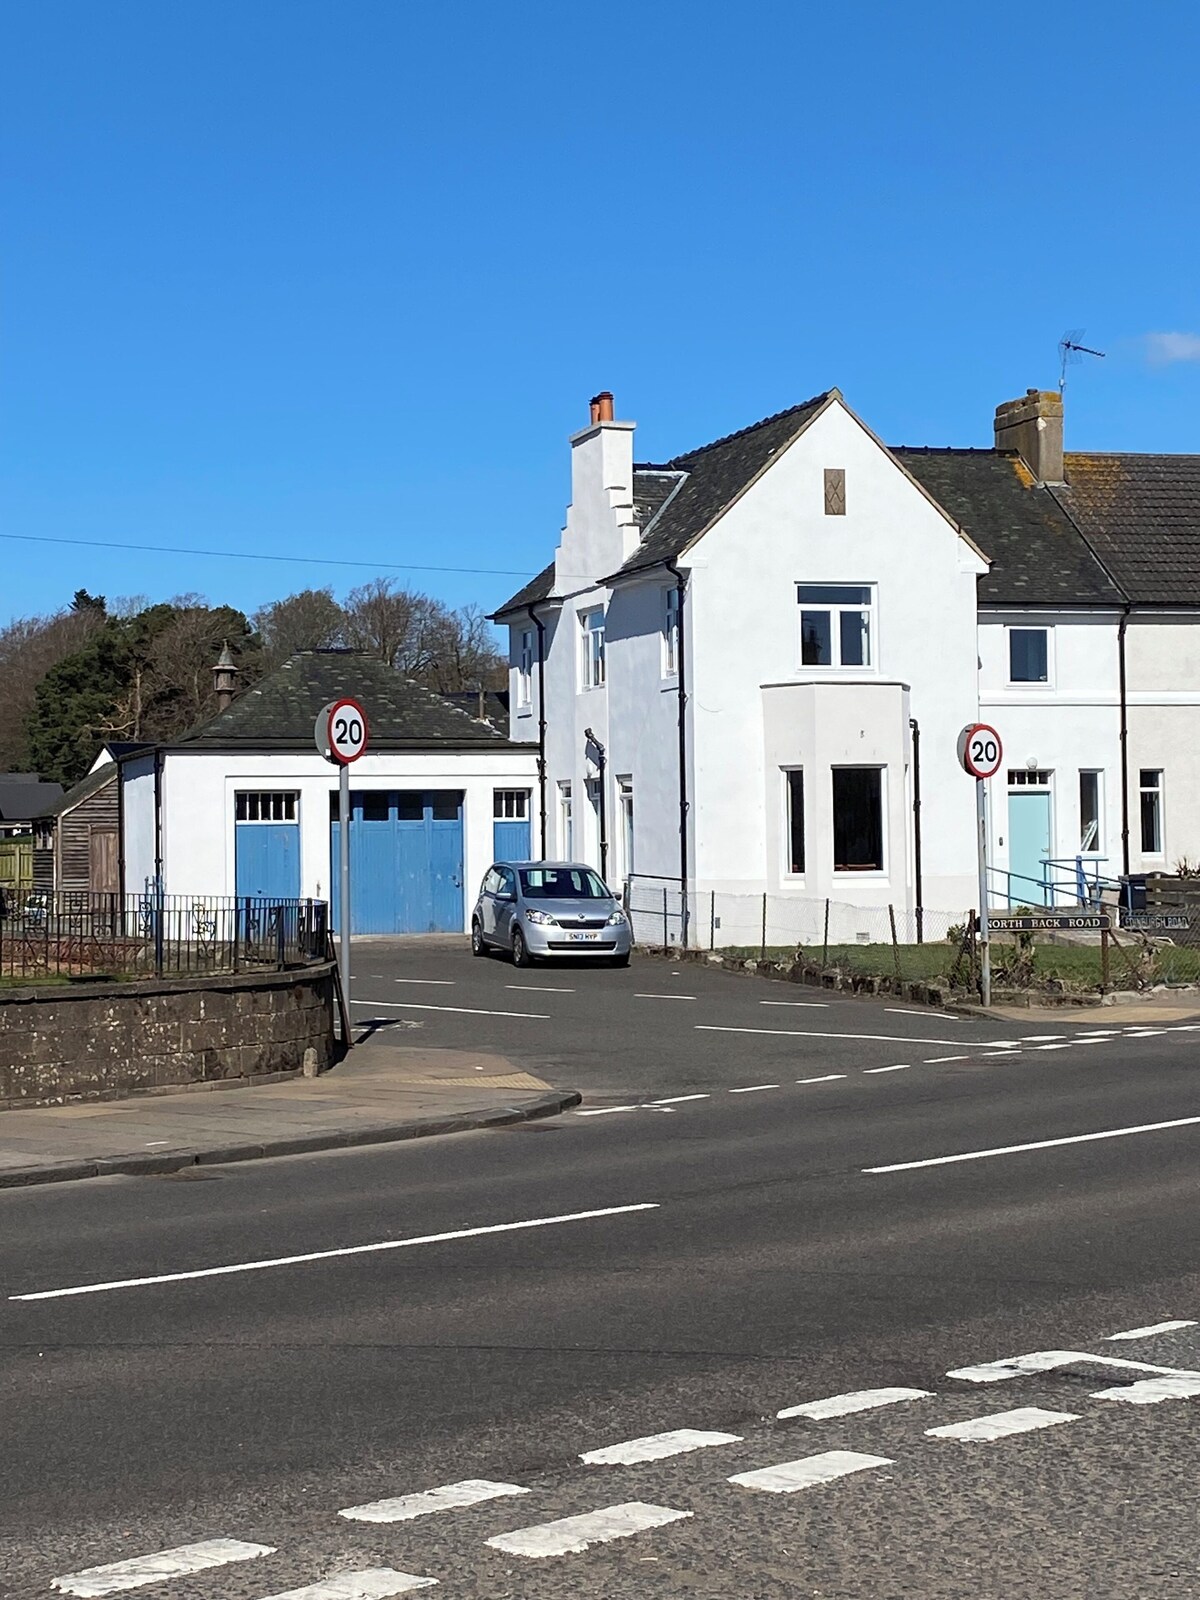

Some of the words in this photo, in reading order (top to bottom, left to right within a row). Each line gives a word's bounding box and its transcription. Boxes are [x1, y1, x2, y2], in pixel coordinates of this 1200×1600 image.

[335, 718, 363, 745] 20
[972, 740, 997, 762] 20
[1031, 919, 1061, 928] BACK
[1068, 918, 1101, 928] ROAD
